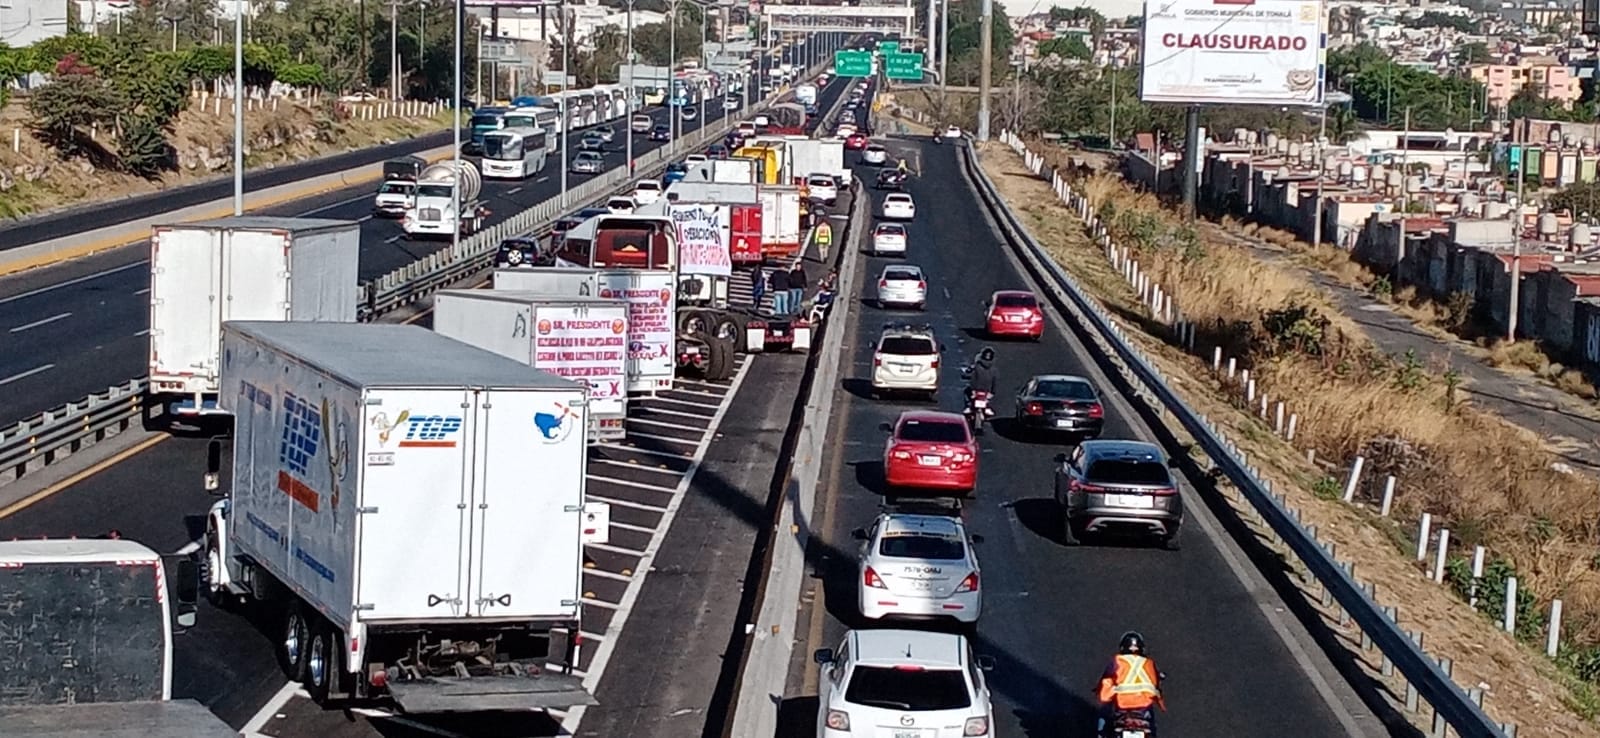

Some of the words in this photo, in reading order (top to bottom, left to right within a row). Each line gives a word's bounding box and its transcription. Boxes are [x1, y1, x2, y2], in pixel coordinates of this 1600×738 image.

[1162, 32, 1307, 51] CLAUSURADO
[567, 320, 611, 330] PRESIDENTE
[405, 415, 462, 440] TGP
